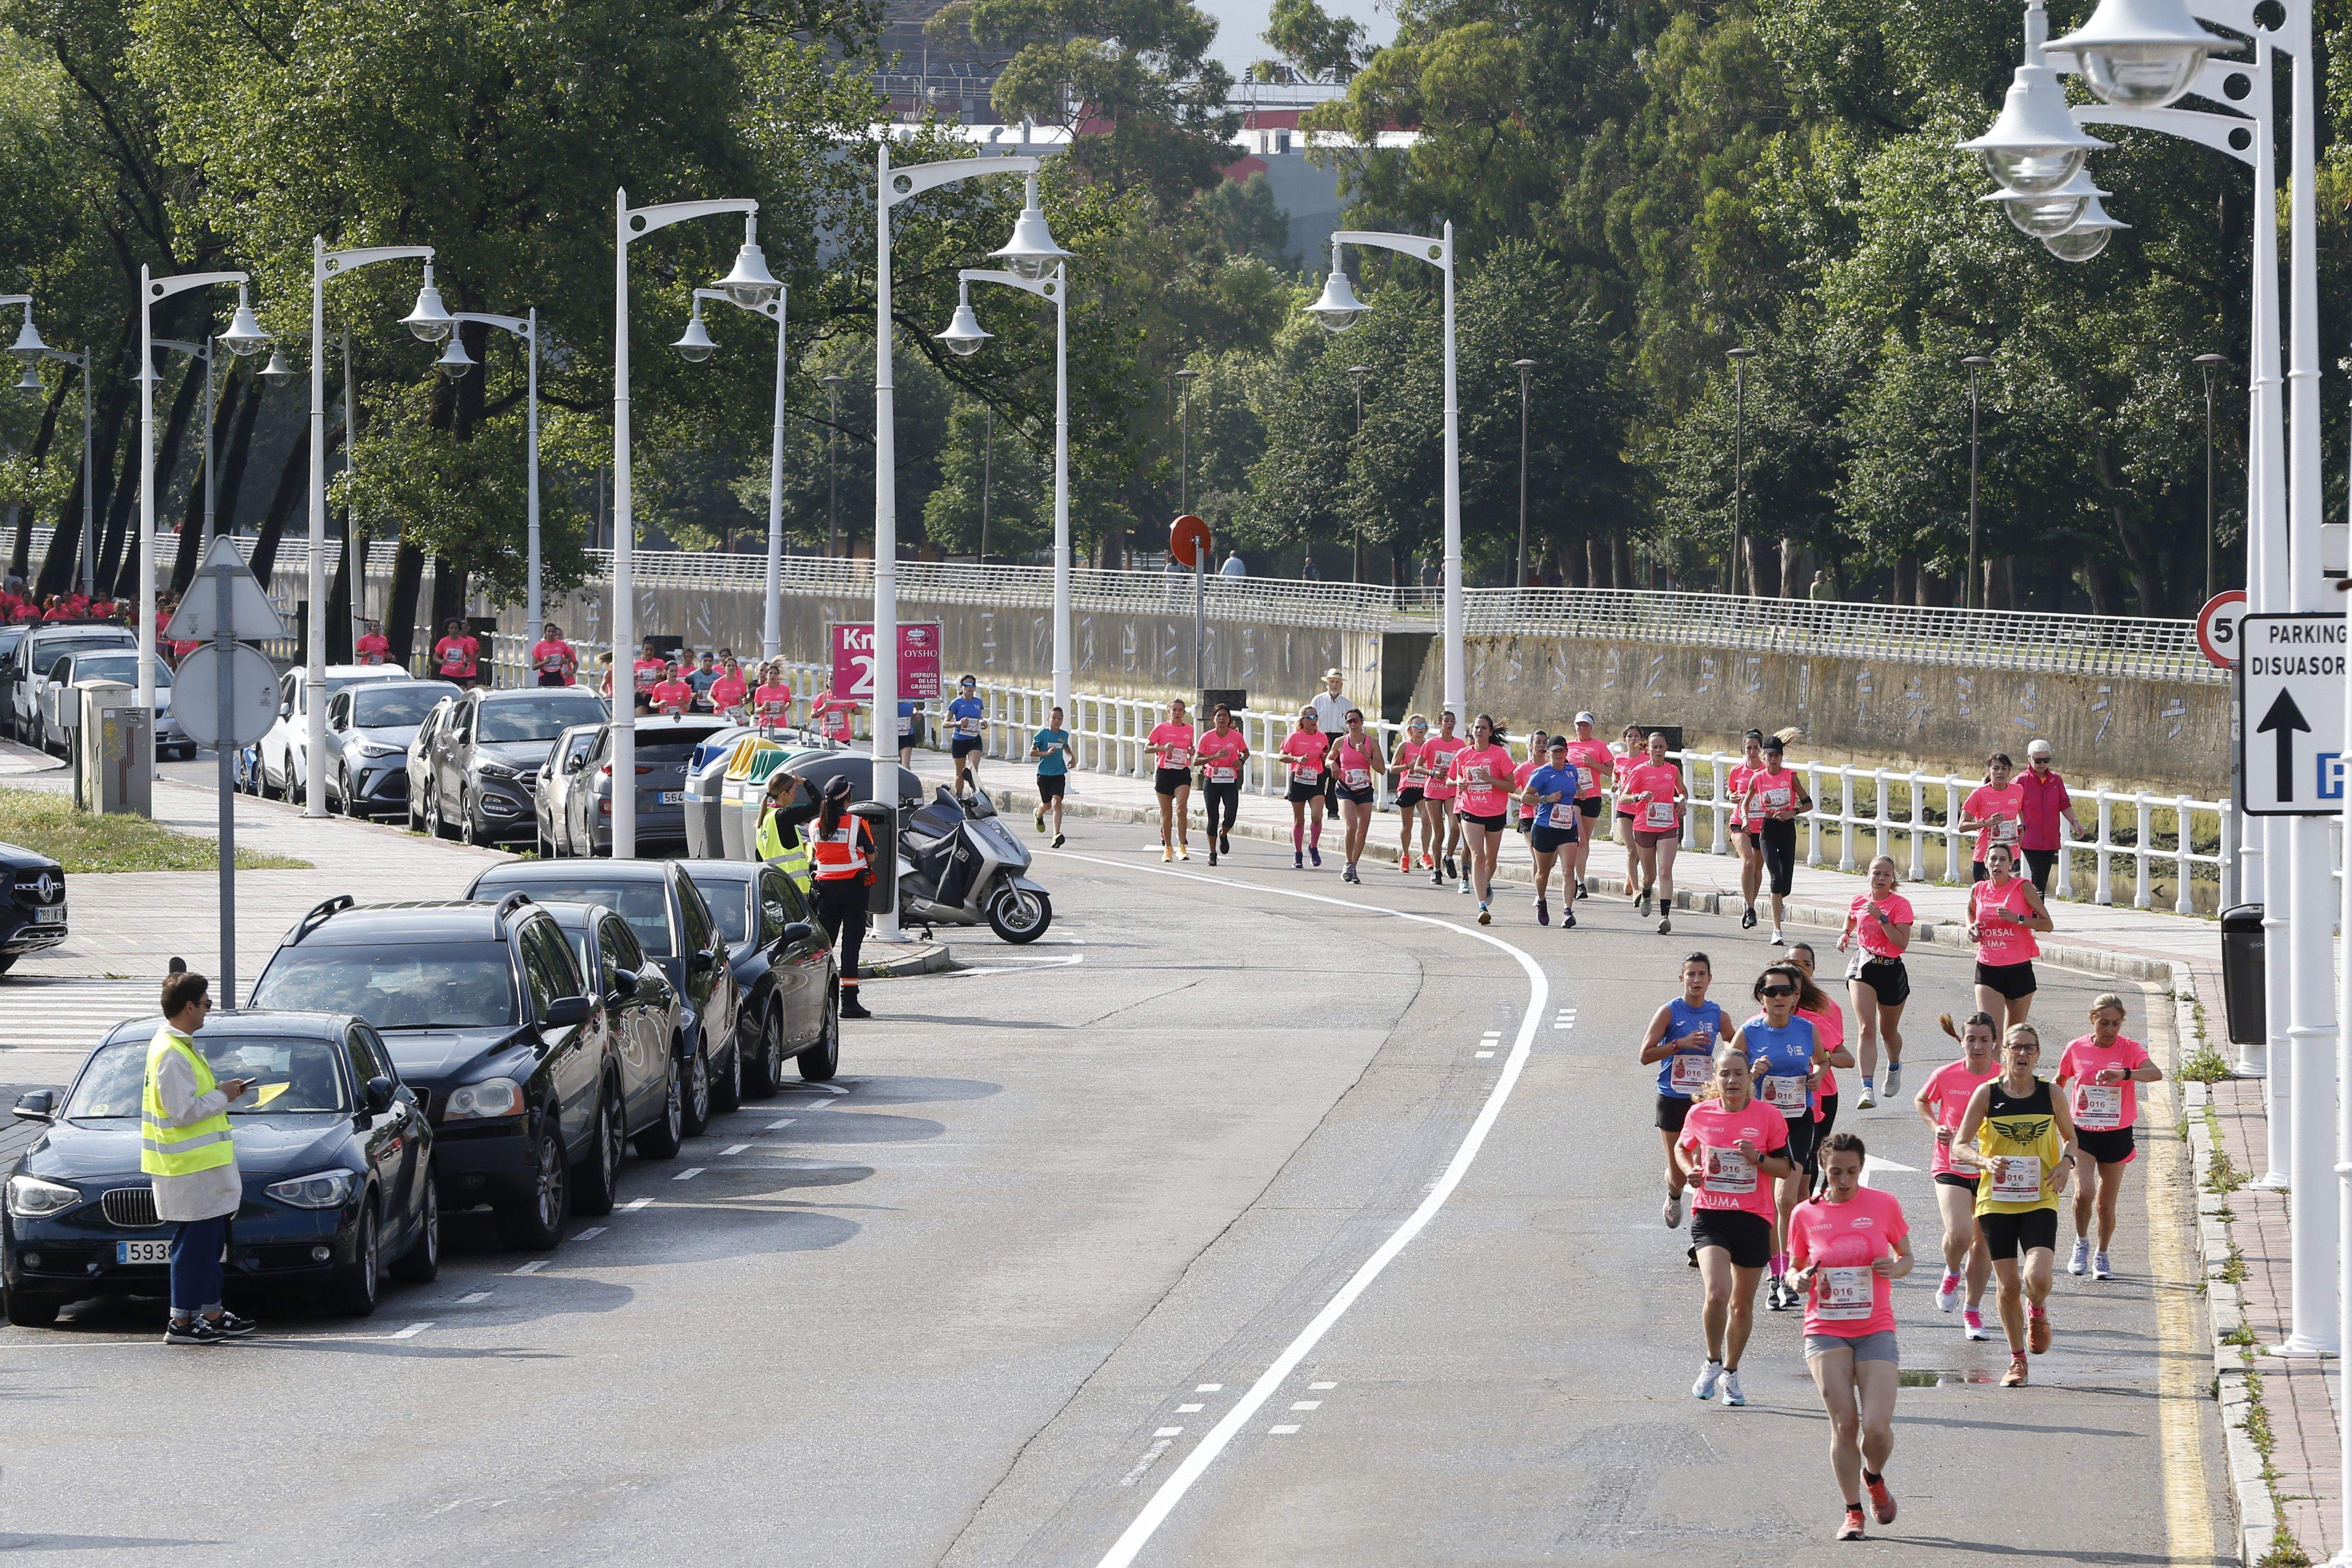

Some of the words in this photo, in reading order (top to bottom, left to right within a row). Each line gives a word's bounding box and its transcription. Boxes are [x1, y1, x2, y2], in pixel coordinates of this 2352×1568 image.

[2269, 625, 2347, 644] PARKING
[904, 649, 938, 658] OYSHO
[849, 655, 874, 694] 2
[665, 793, 683, 803] 564
[39, 909, 52, 921] 7891
[1702, 1195, 1740, 1208] SUMA
[1833, 1287, 1853, 1296] 016
